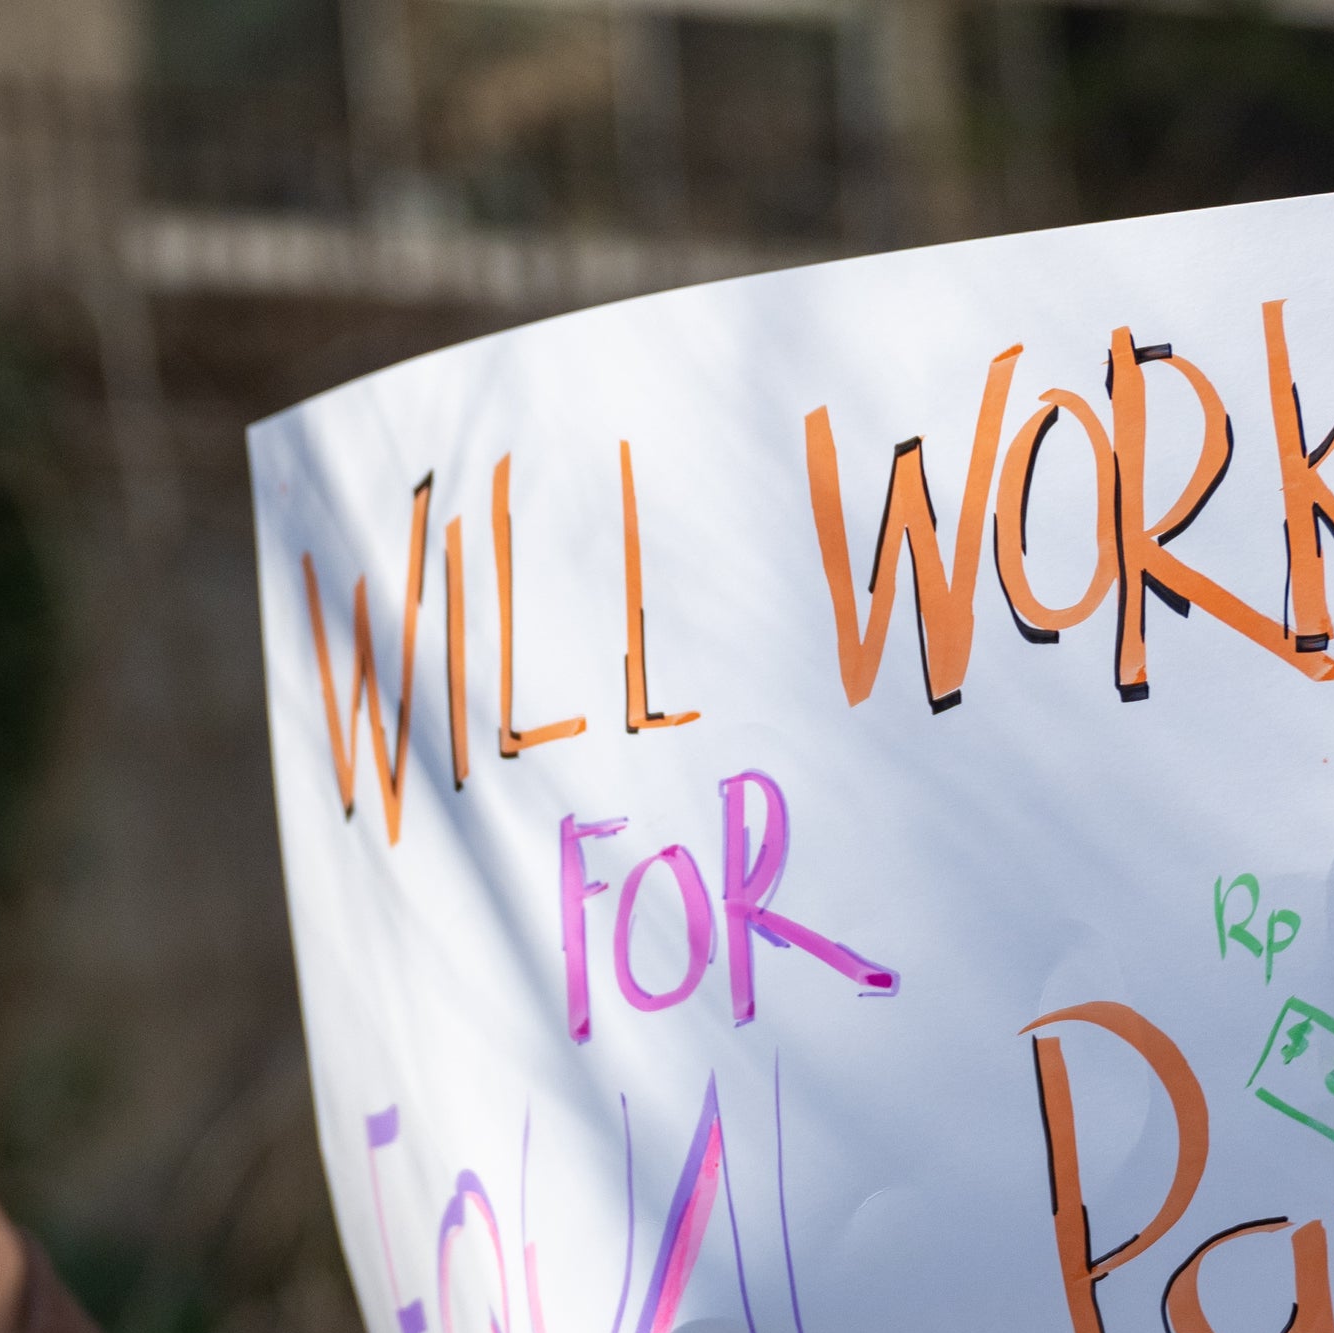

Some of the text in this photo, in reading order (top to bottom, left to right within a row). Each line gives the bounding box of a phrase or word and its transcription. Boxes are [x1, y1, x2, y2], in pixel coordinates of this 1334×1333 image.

[302, 439, 701, 847] WILL
[559, 768, 900, 1045] FOR
[1214, 873, 1302, 986] Rp
